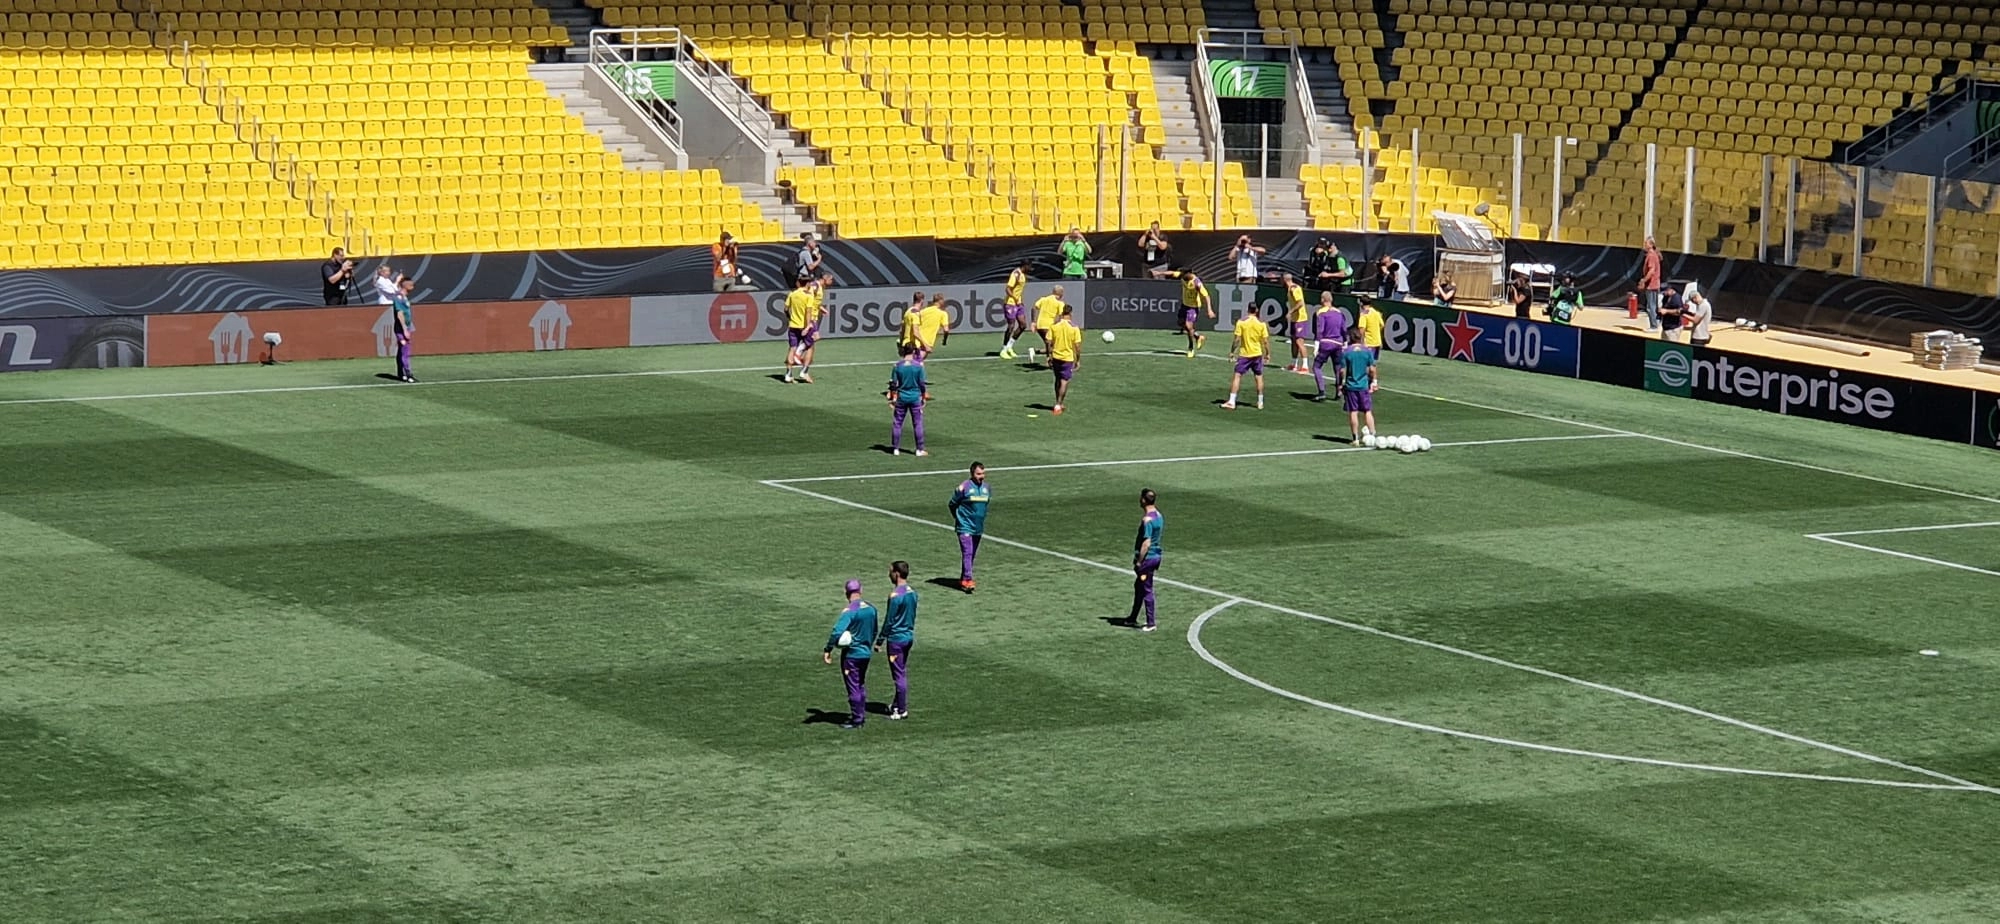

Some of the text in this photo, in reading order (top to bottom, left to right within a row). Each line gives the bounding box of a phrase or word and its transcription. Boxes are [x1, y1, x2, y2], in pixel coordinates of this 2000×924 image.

[624, 68, 652, 94] 15
[1230, 66, 1260, 91] 17
[765, 291, 1008, 337] Sissqote
[1111, 297, 1179, 313] RESPECT
[1644, 349, 1895, 418] enterprise
